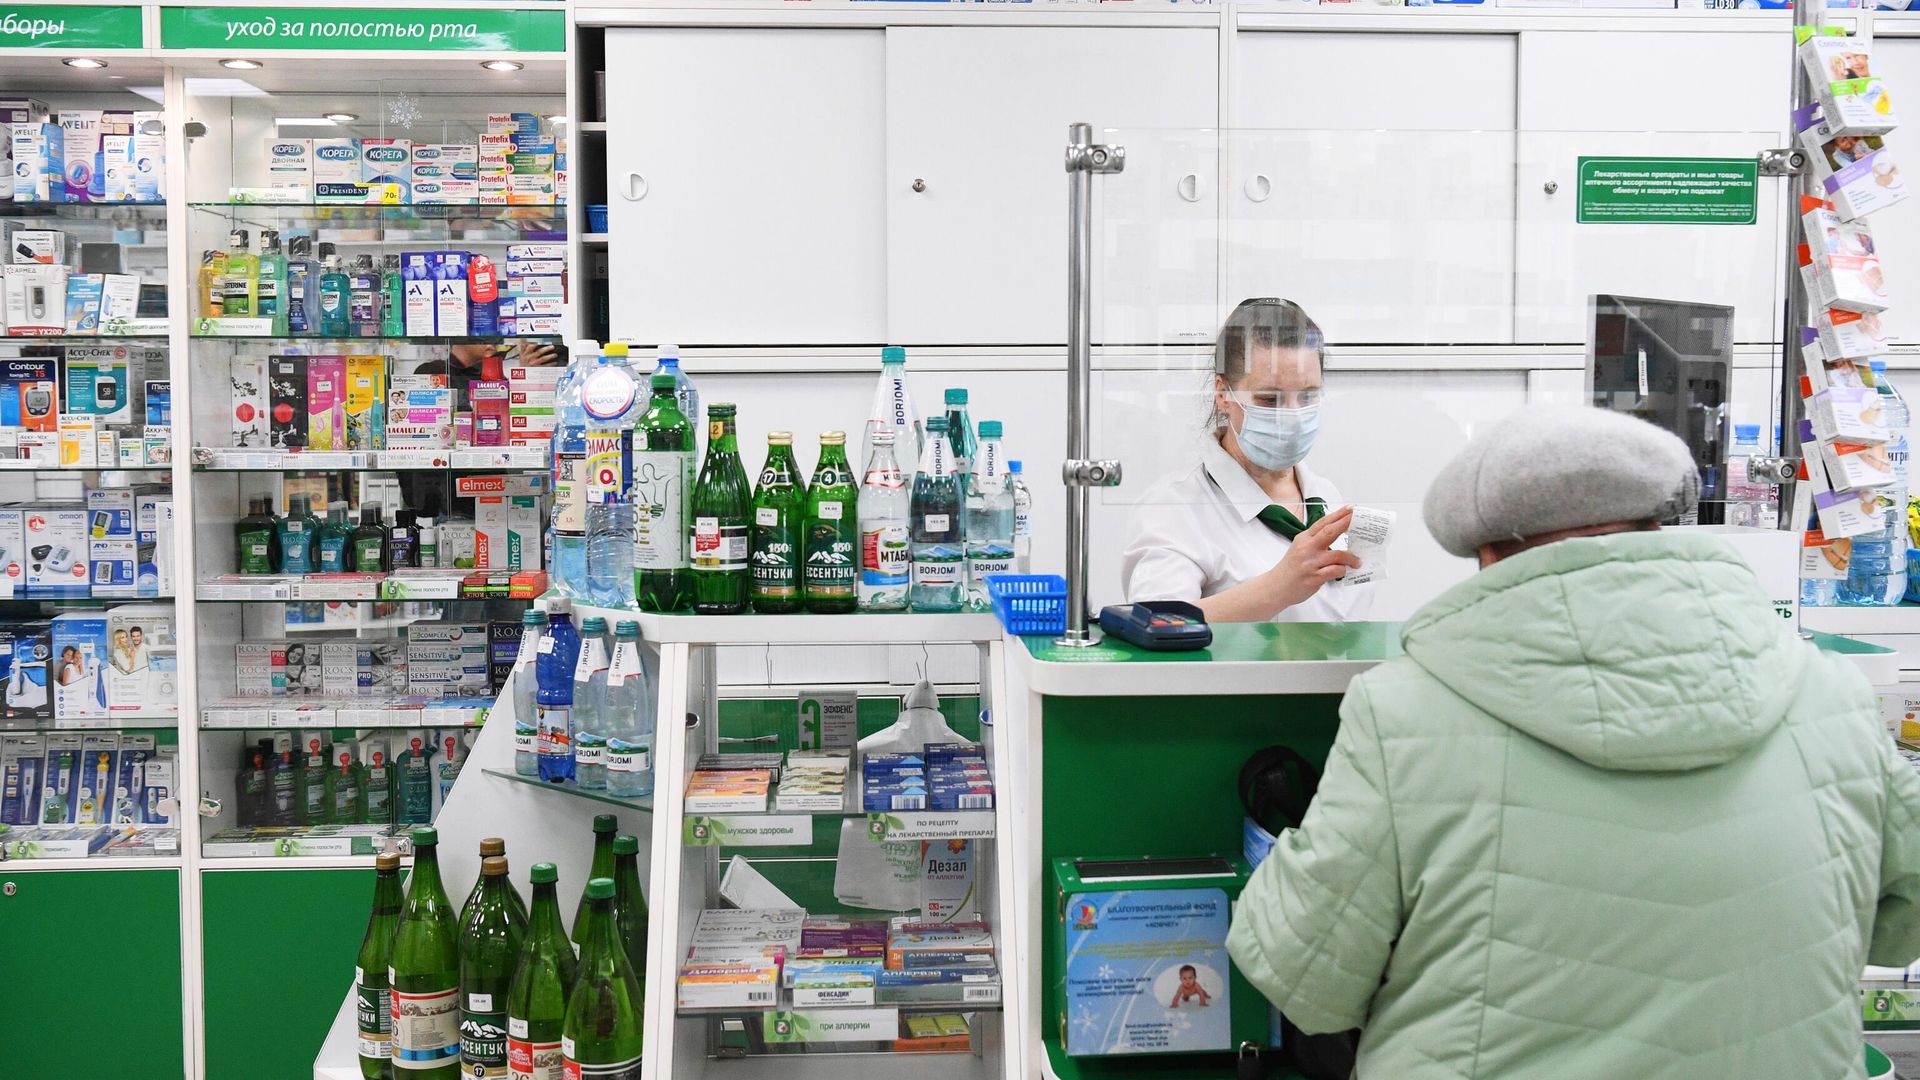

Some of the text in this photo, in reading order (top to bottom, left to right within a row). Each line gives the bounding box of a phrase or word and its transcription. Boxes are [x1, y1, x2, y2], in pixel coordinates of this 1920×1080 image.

[225, 16, 477, 41] уход за полостью рта
[321, 149, 354, 158] КОРЕГА
[369, 150, 403, 159] КОРЕГА
[38, 328, 62, 336] YX200
[9, 362, 45, 370] Contour
[34, 370, 45, 378] TS
[893, 378, 905, 425] BORJOMI
[513, 418, 525, 426] SPLAT
[763, 472, 773, 482] 17
[824, 474, 832, 484] 4
[462, 480, 503, 490] elmex
[768, 543, 789, 553] 150
[832, 542, 851, 553] 150
[806, 567, 854, 578] ЕССЕНТУКИ
[919, 566, 956, 574] BORJOMI
[974, 564, 1009, 572] BORJOMI
[824, 705, 853, 714] ЭФФЕКС
[898, 830, 958, 838] ЛЕКАРСТВЕННЫЙ
[928, 860, 967, 874] Дезал
[1108, 902, 1216, 914] БЛАГОТВОРИТЕЛЬНЫЙ ФОНД
[820, 1022, 870, 1032] при аллергии
[474, 1067, 483, 1076] 17
